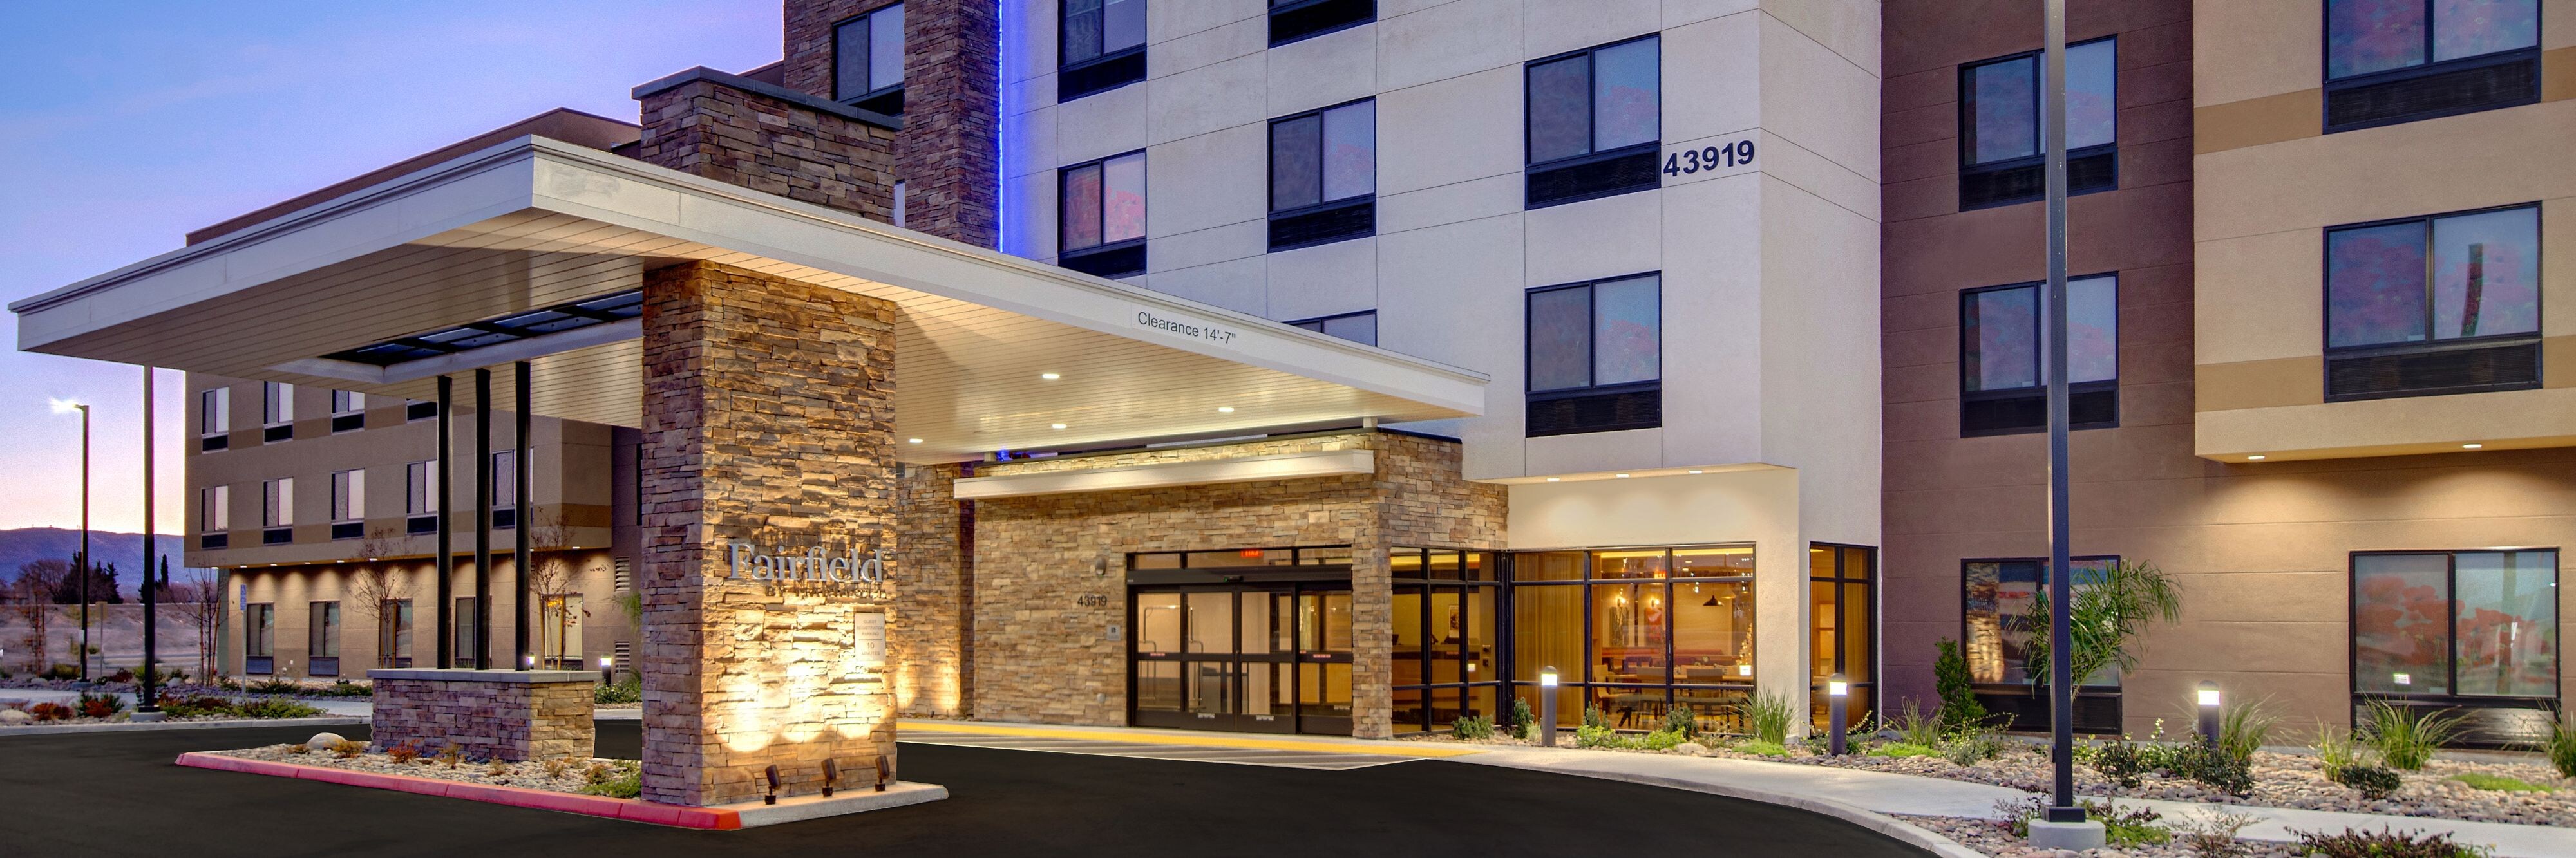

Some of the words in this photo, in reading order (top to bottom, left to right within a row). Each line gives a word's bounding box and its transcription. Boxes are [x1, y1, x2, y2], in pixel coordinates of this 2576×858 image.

[1663, 140, 1755, 177] 43919
[1138, 312, 1199, 337] Clearance
[1204, 327, 1236, 344] 14'-7"
[728, 542, 883, 582] Fairfield
[1077, 595, 1107, 606] 43919
